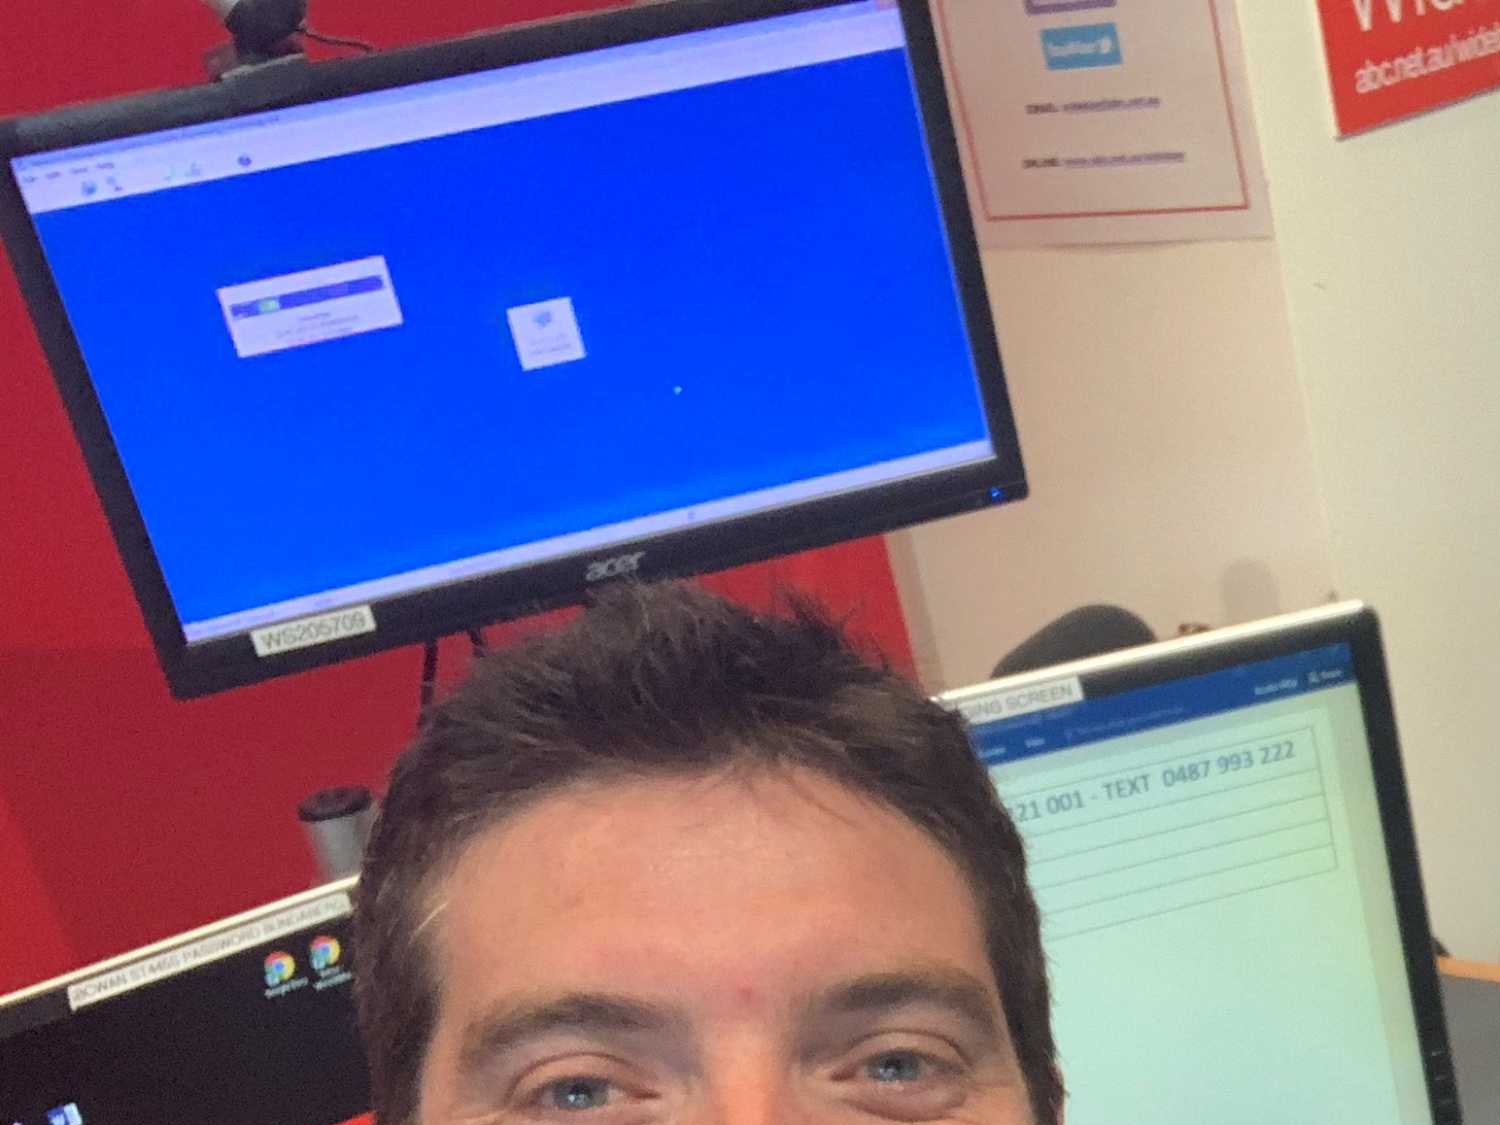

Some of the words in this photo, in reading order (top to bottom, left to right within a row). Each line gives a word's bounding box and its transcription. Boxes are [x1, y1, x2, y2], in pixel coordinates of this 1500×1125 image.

[585, 552, 646, 582] acer
[261, 612, 366, 650] WS205709
[1006, 684, 1073, 710] SCREEN
[1046, 793, 1085, 817] 001
[1101, 774, 1151, 803] TEXT
[1162, 762, 1210, 789] 0487
[1217, 752, 1255, 775] 993
[1259, 740, 1296, 766] 222
